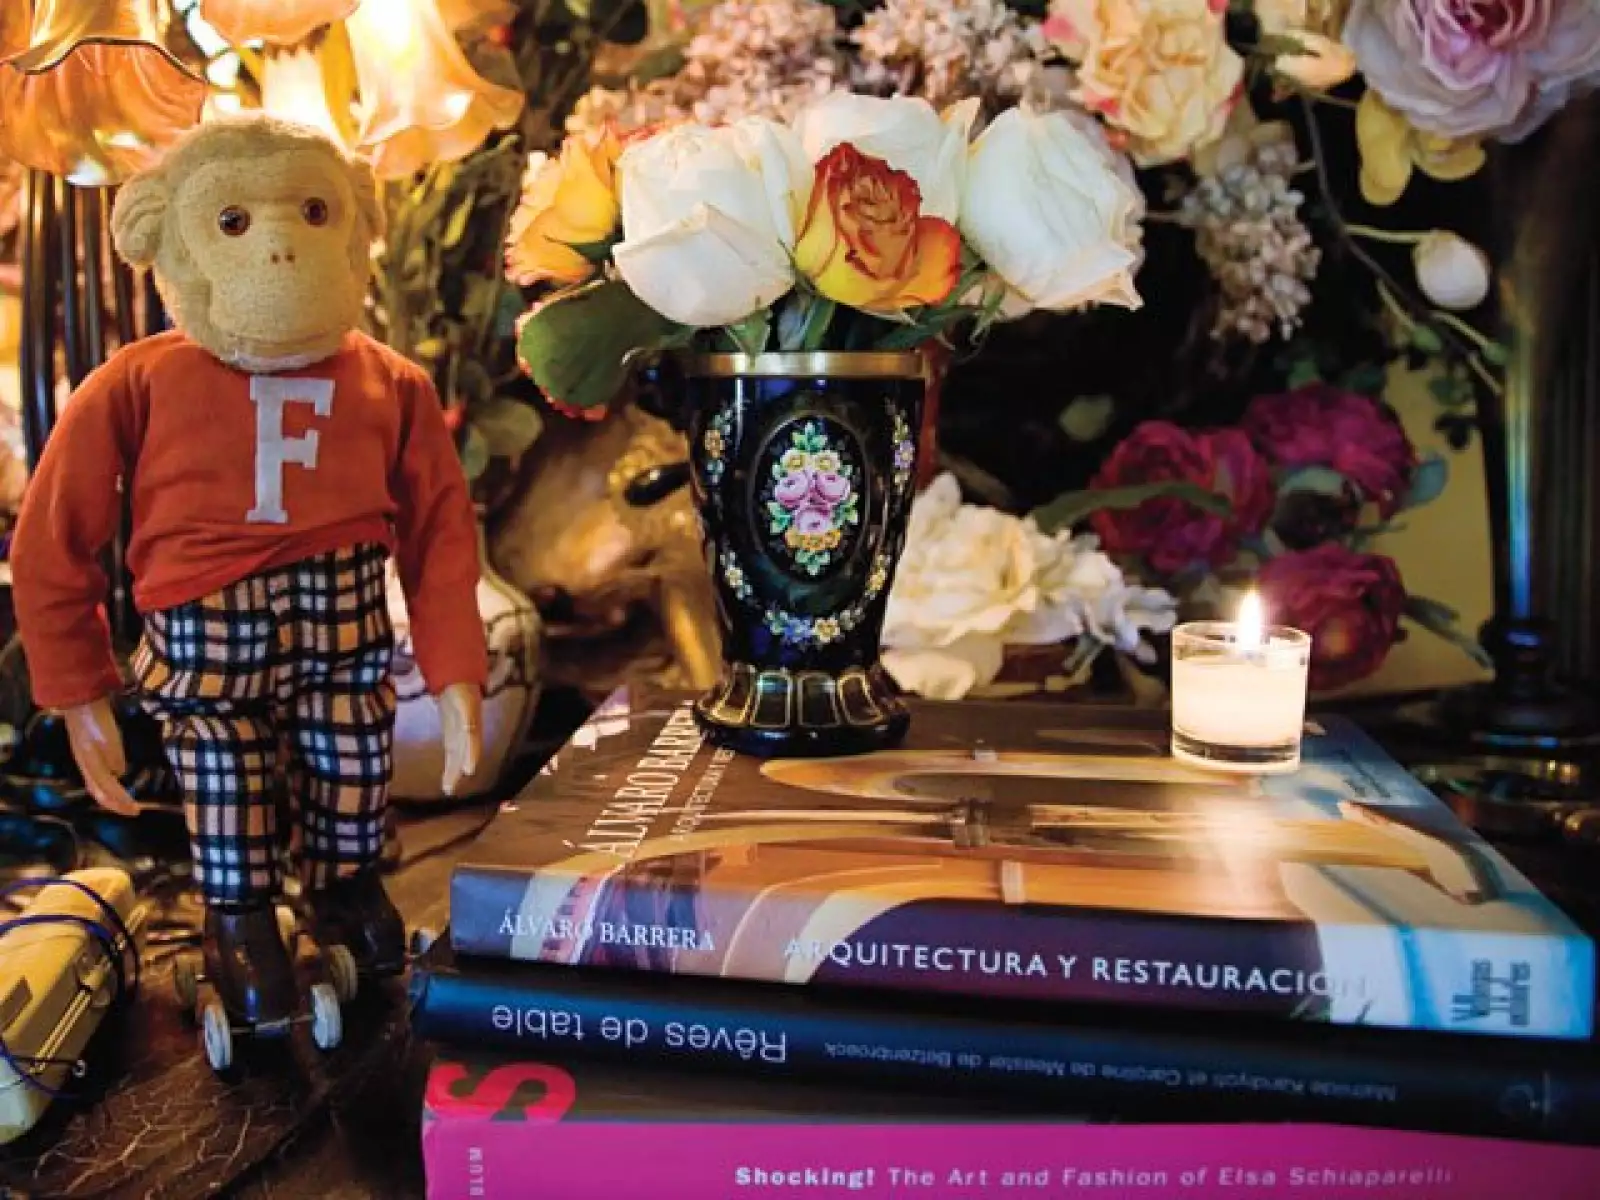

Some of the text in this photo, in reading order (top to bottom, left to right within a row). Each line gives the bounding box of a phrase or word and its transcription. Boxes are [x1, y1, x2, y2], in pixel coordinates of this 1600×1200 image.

[246, 376, 335, 524] F
[499, 906, 716, 951] ÁLVARO BARRERA
[785, 938, 1048, 979] ARQUITECTURA
[1056, 954, 1078, 980] Y
[491, 1004, 786, 1063] Rêves de table
[469, 1146, 484, 1196] BLUM
[734, 1166, 1451, 1190] Shocking! The Art and Fashion of Elsa Schiaparelli
